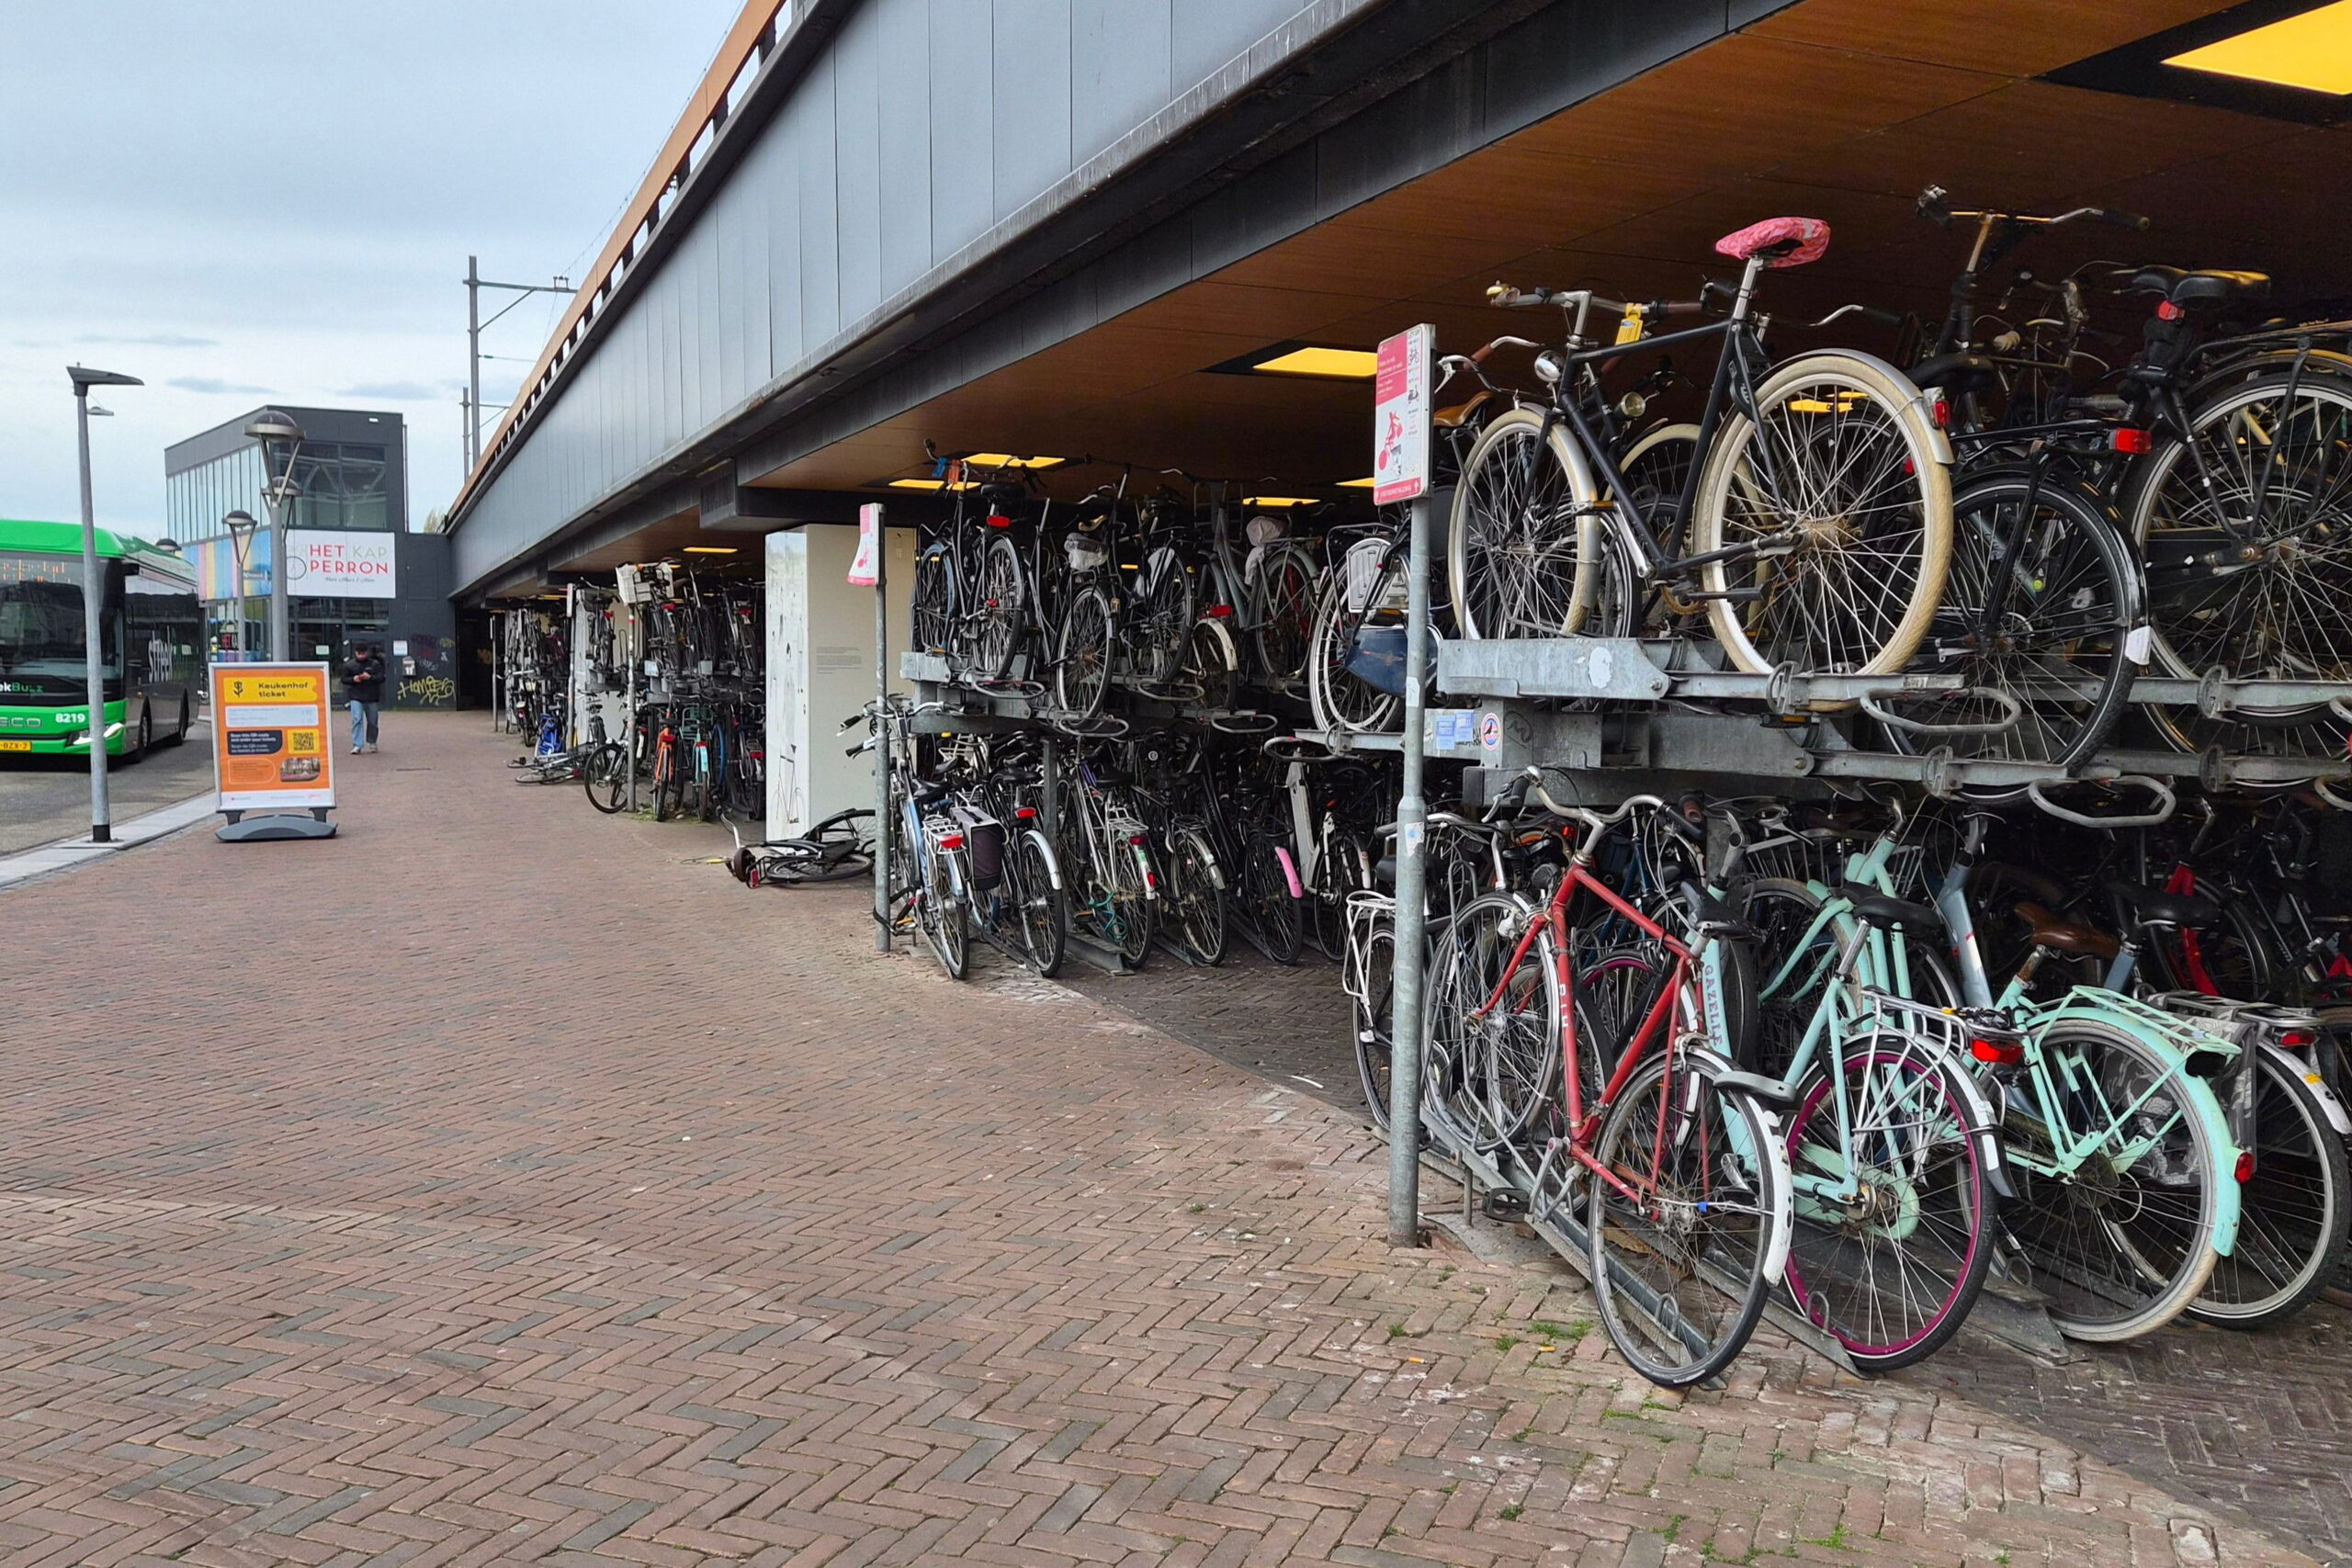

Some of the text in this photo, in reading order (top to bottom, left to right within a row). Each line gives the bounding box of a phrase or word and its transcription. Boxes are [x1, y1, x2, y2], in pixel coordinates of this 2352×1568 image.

[310, 544, 388, 558] HET KAP
[310, 560, 389, 574] PERRON
[258, 689, 286, 698] ticket
[55, 713, 85, 724] 8219
[1704, 964, 1724, 1047] GAZELLE
